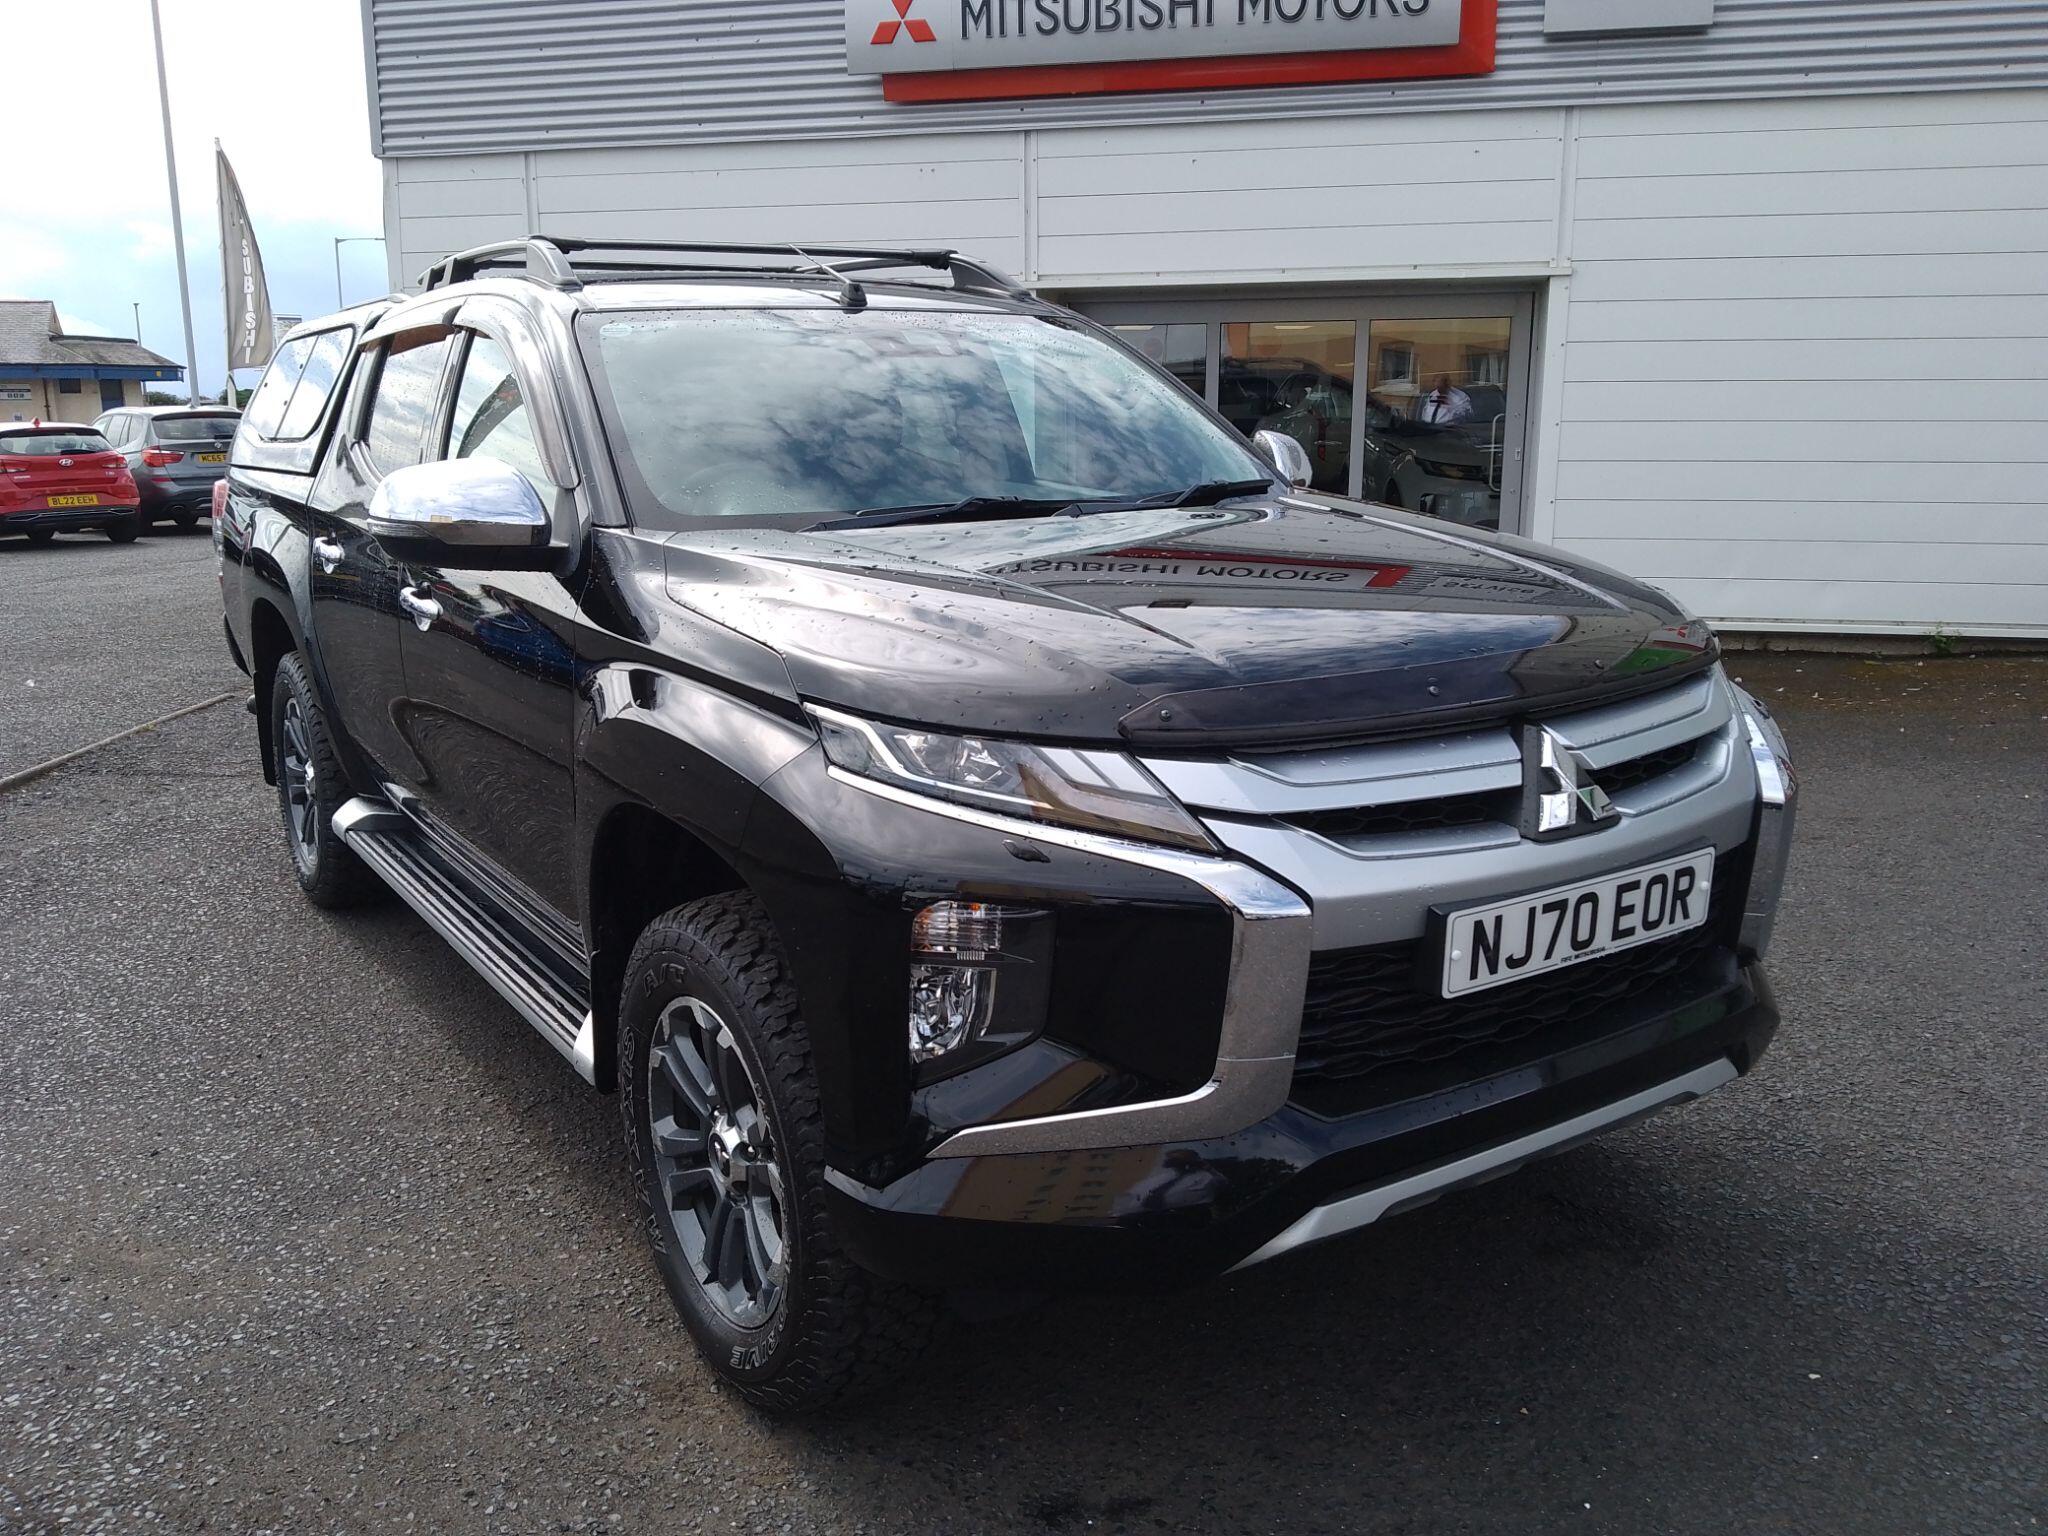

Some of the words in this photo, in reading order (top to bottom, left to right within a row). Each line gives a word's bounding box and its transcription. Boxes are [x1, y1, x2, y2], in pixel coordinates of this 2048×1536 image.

[961, 0, 1215, 39] MITSUBISHI
[51, 497, 76, 506] BL22
[1470, 892, 1600, 981] NJ70
[1611, 865, 1696, 942] EOR
